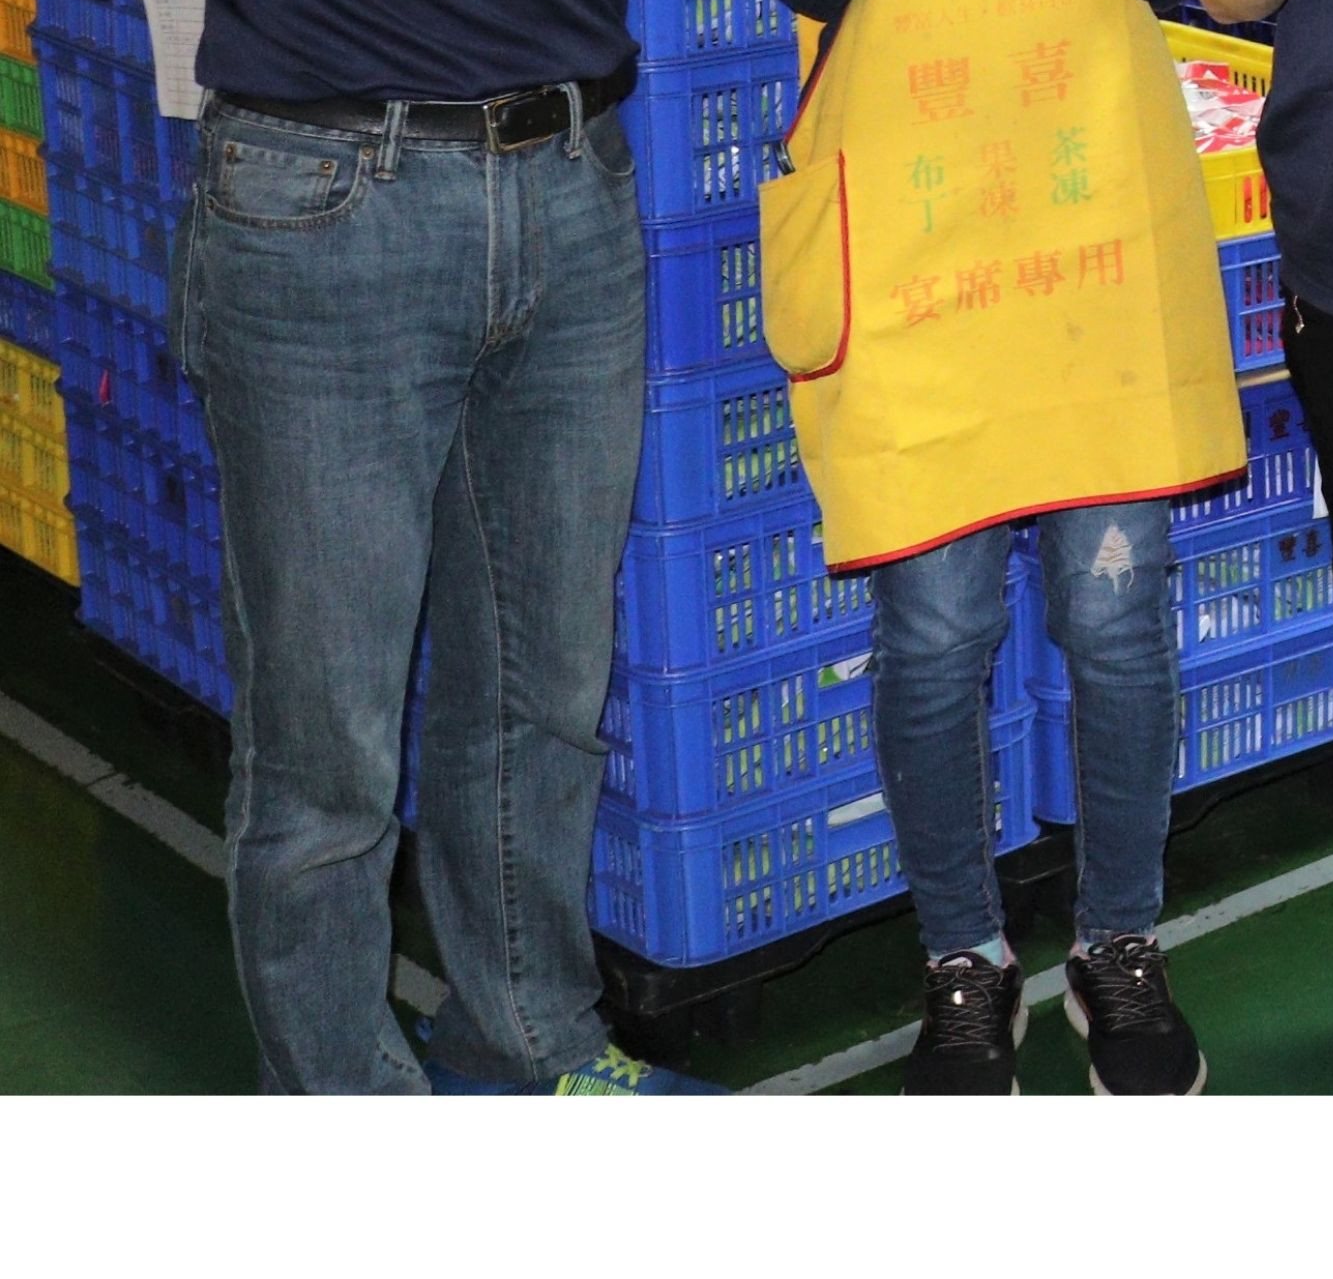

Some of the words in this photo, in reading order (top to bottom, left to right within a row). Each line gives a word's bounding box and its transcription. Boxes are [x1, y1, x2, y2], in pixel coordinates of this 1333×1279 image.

[907, 153, 945, 234] 布丁
[979, 140, 1019, 217] 果凍
[1050, 126, 1091, 206] 茶凍
[890, 238, 1126, 329] 宴席專用
